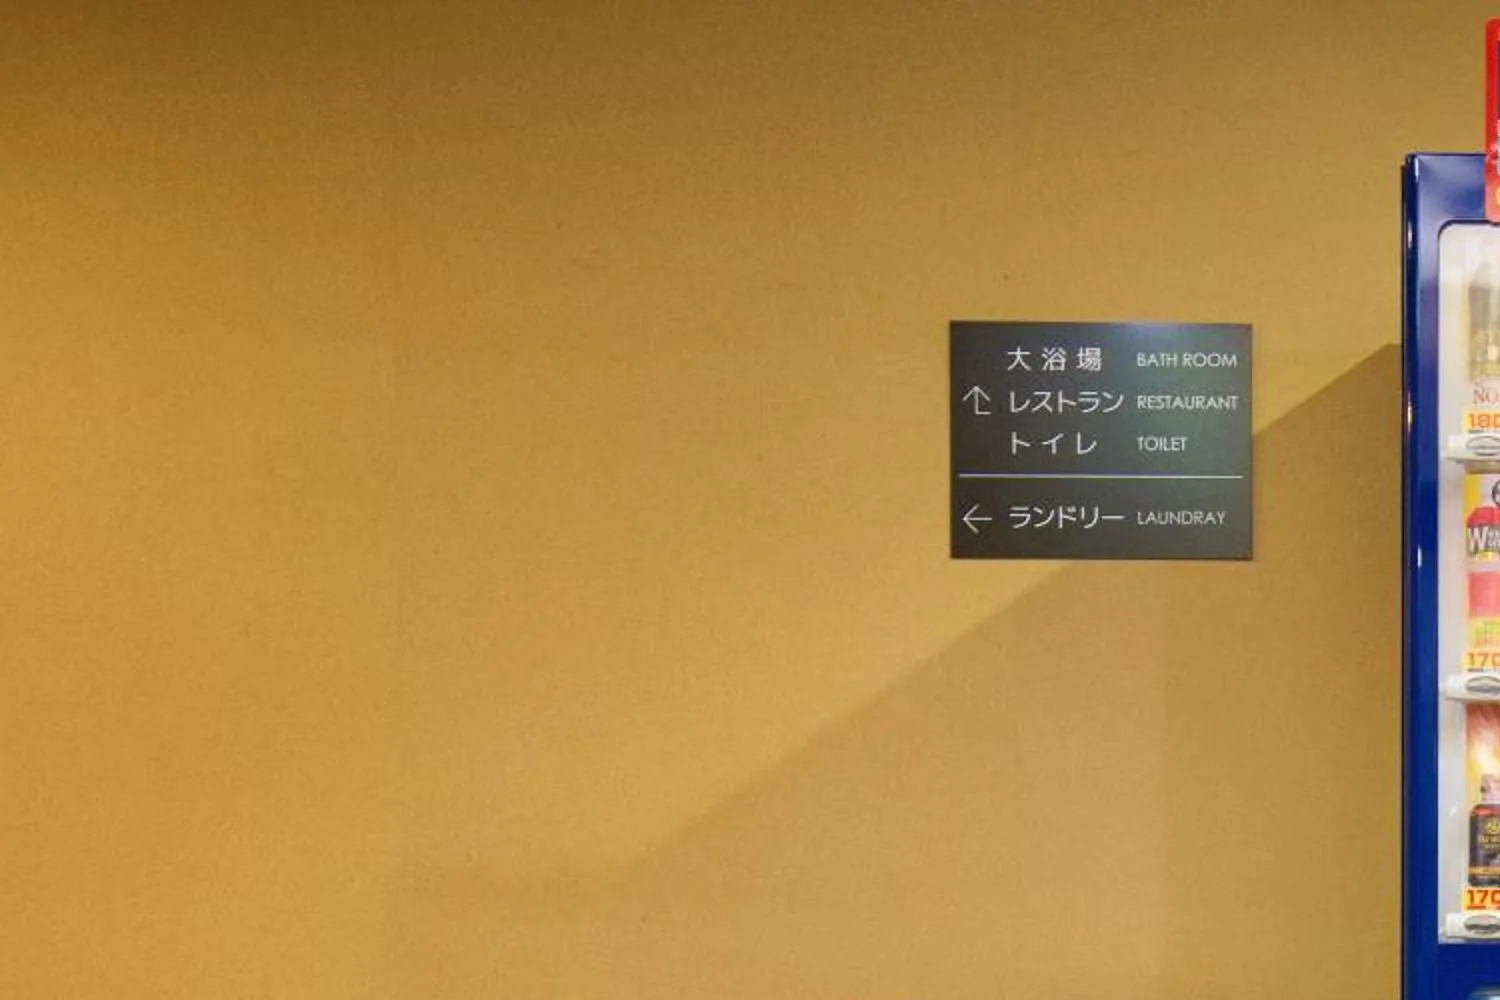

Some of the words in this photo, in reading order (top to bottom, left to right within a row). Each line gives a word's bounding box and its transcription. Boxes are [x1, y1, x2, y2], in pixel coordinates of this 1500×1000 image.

[1007, 347, 1102, 371] 大浴場
[1137, 353, 1178, 368] BATH
[1182, 353, 1237, 368] ROOM
[1010, 391, 1124, 413] レストラン
[1137, 396, 1238, 410] RESTAURANT
[1012, 432, 1097, 455] トイレ
[1137, 436, 1187, 451] TOILET
[1010, 506, 1125, 529] ランドリー
[1137, 511, 1226, 525] LAUNDRAY
